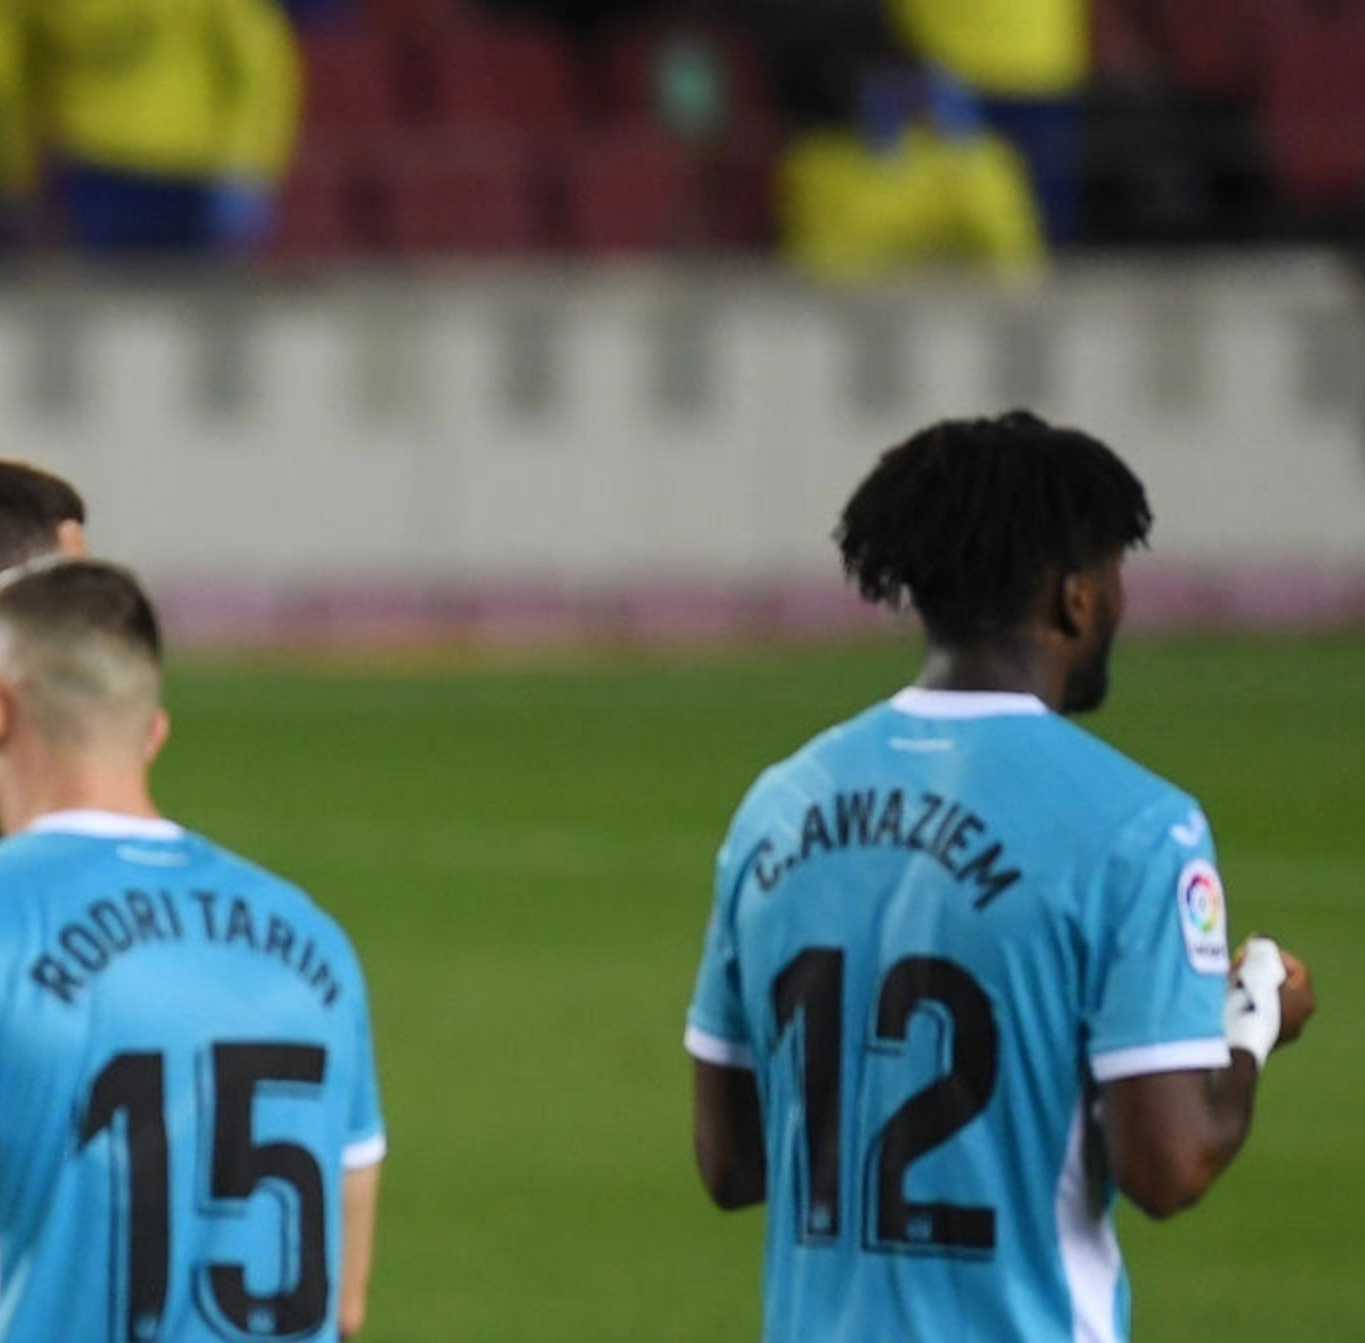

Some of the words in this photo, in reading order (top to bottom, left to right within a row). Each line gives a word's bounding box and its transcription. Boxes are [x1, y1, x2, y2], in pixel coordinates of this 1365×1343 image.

[754, 787, 1022, 911] C.AWAZIEM
[30, 887, 184, 1006] RODRI
[771, 945, 997, 1262] 12
